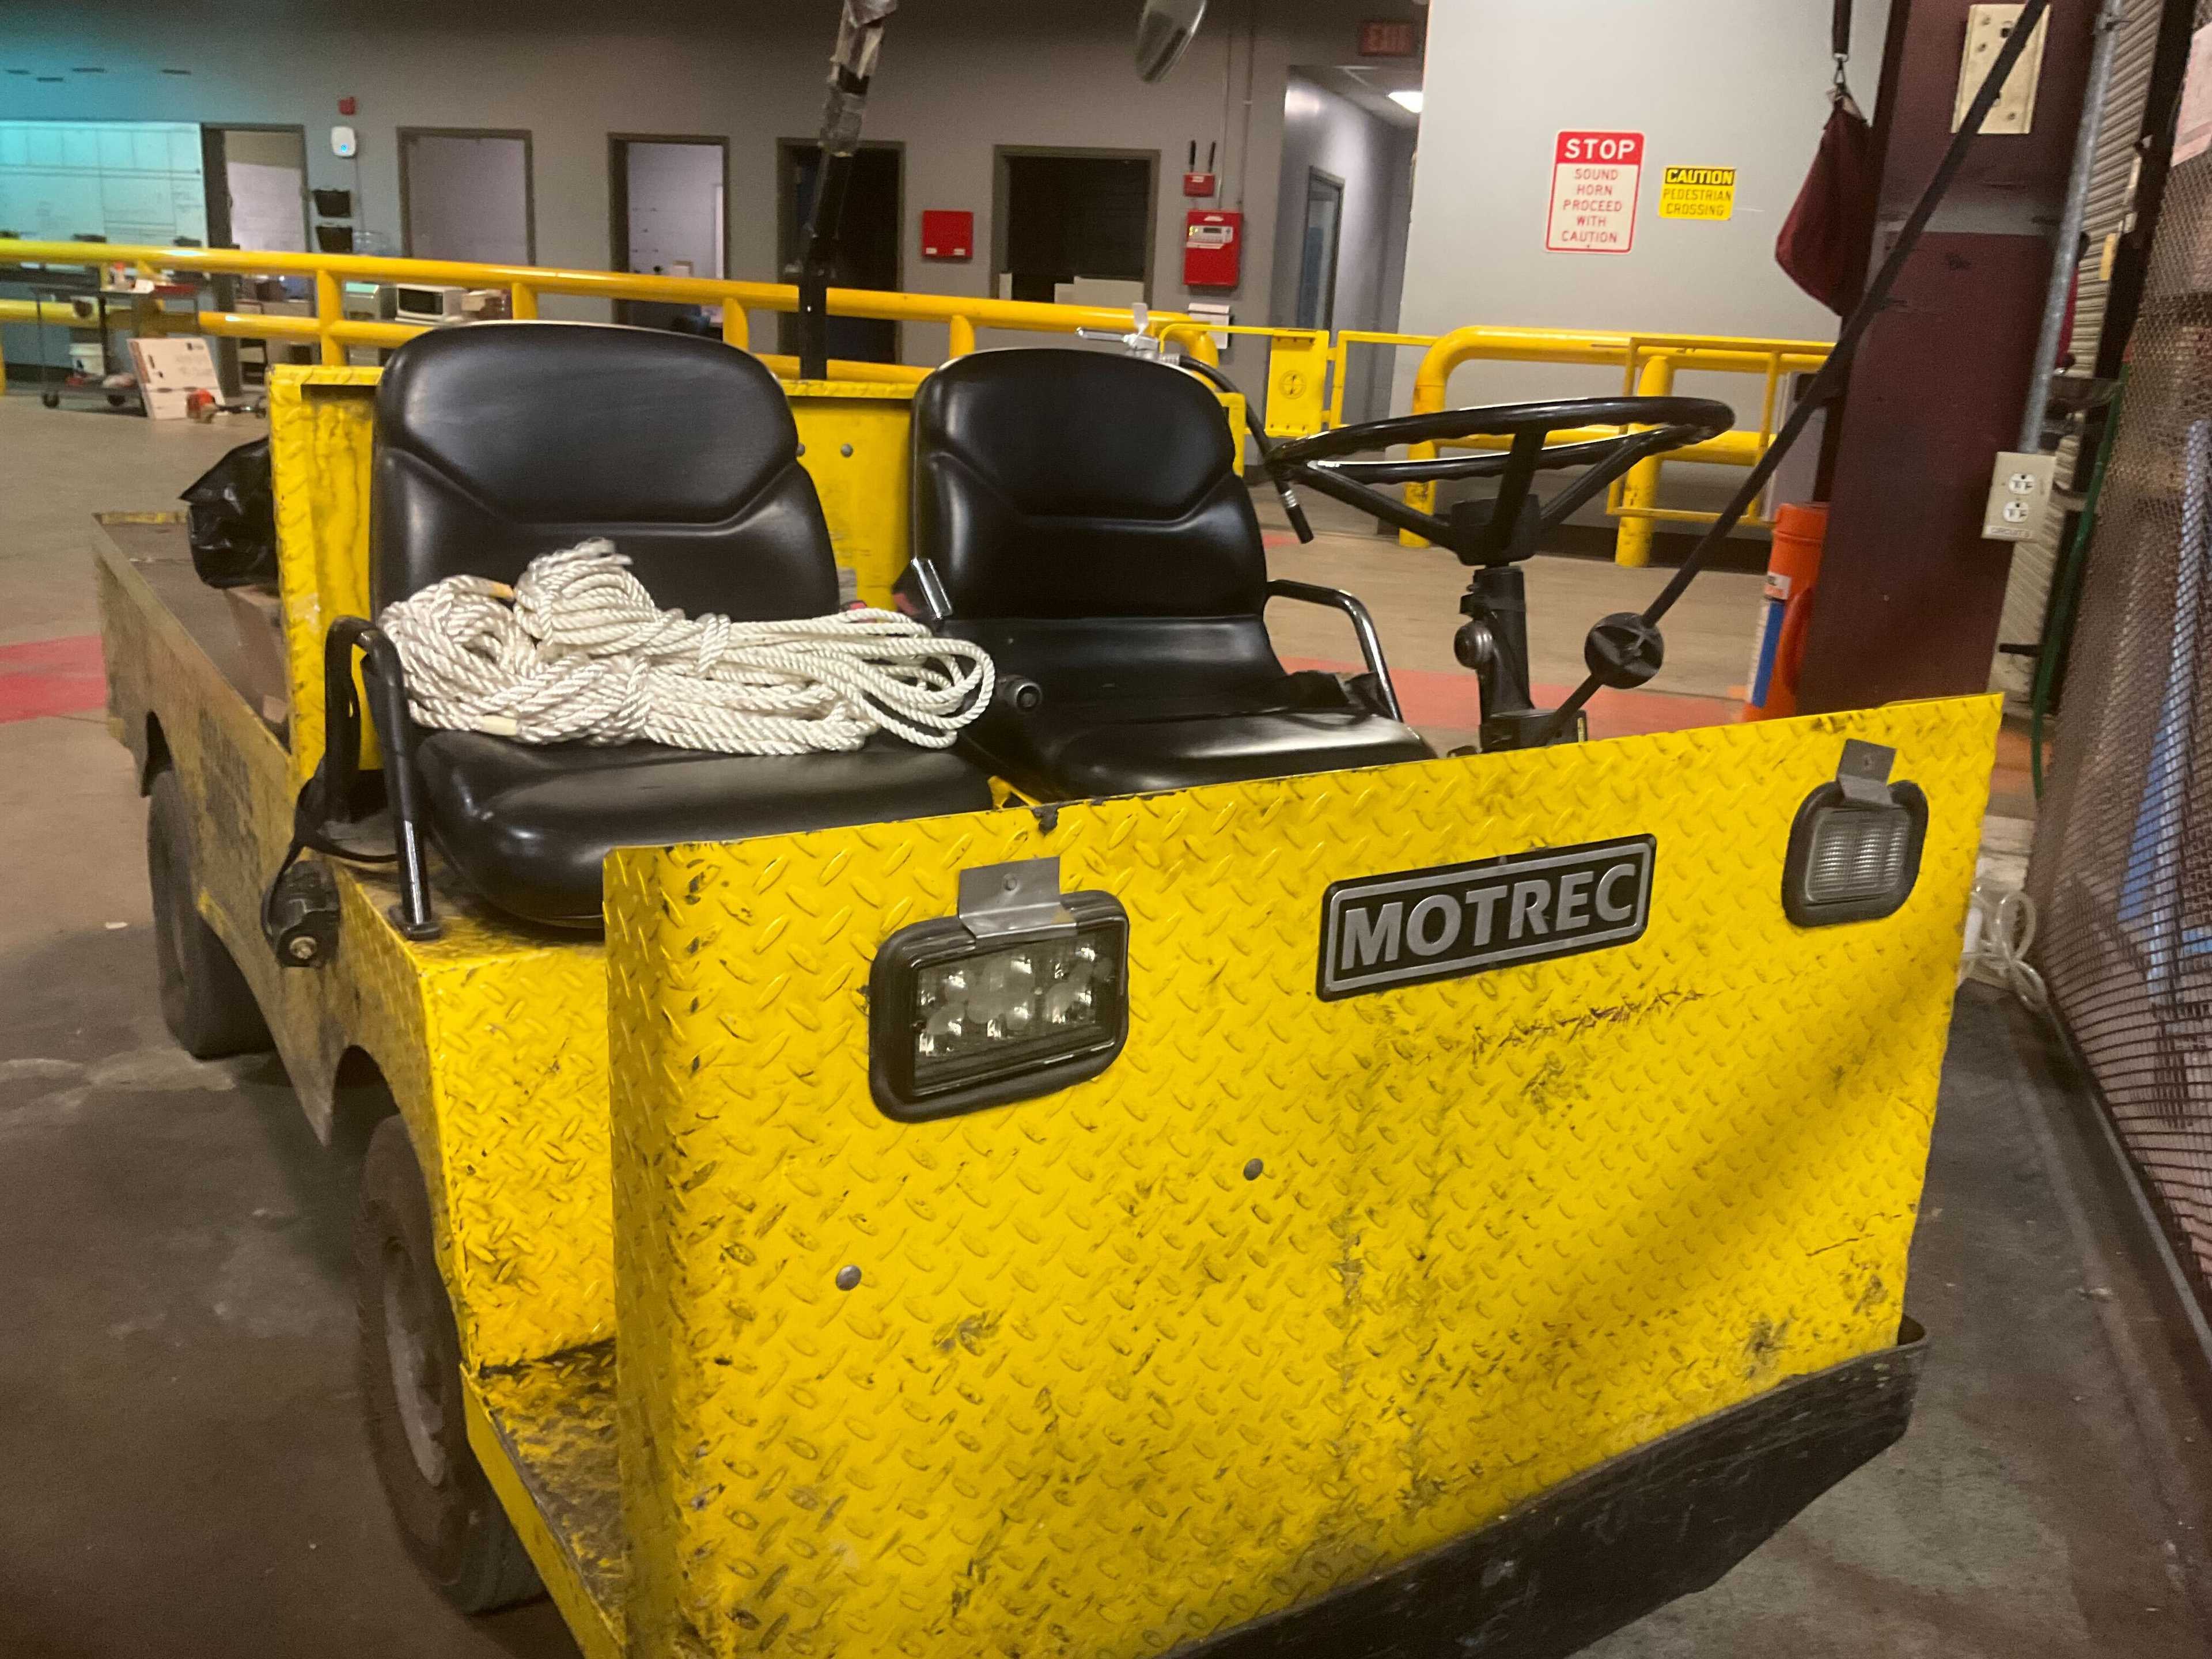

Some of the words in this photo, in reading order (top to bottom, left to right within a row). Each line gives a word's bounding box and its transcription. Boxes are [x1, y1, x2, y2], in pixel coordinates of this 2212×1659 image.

[1565, 139, 1635, 160] STOP
[1575, 169, 1618, 180] SOUND
[1666, 169, 1734, 184] CAUTION
[1577, 185, 1612, 196] HORN
[1664, 188, 1732, 202] PEDESTRIAN
[1563, 200, 1622, 212] PROCEED
[1666, 203, 1724, 216] CROSSING
[1577, 216, 1606, 226] WITH
[1562, 231, 1617, 243] CAUTION
[1341, 864, 1637, 969] MOTREC
